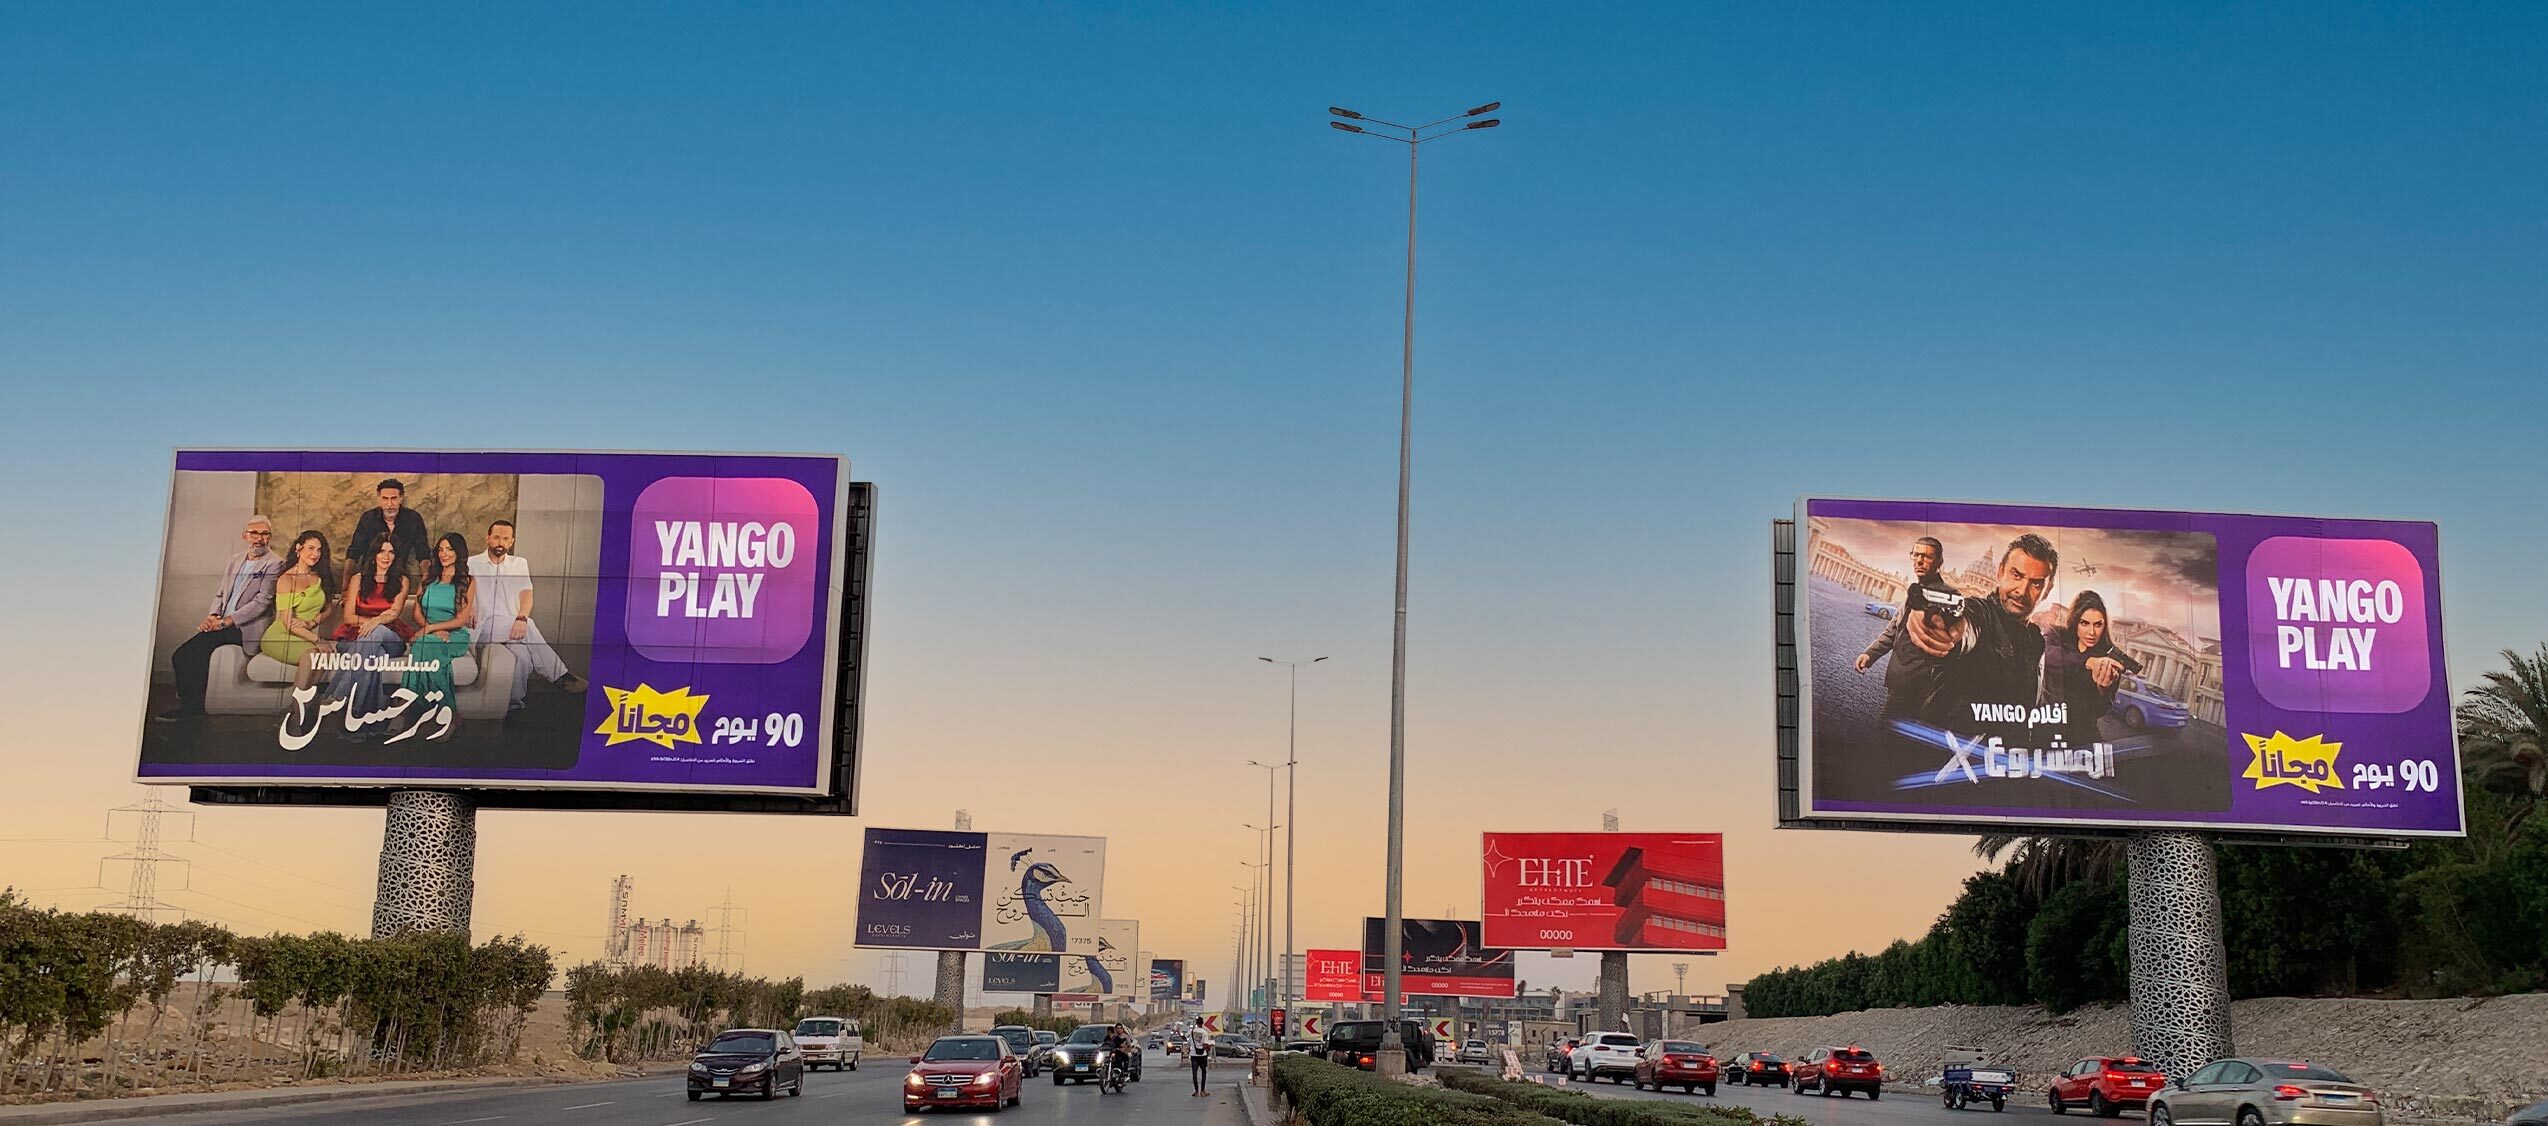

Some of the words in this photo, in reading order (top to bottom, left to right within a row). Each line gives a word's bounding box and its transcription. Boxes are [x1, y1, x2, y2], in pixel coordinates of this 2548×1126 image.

[655, 521, 795, 568] YANGO
[657, 572, 764, 618] PLAY
[2267, 577, 2403, 624] YANGO
[310, 653, 361, 670] YANGO
[363, 654, 440, 672] مسلسلات
[2277, 625, 2377, 671] PLAY
[1971, 703, 2026, 723] YANGO
[2028, 703, 2068, 729] أفلام
[711, 717, 758, 744] يوم
[765, 713, 803, 747] 90
[1935, 730, 1987, 784] X
[1984, 734, 2115, 779] المشروع
[2352, 763, 2394, 790] يوم
[2400, 759, 2439, 792] 90
[1540, 930, 1572, 940] 00000
